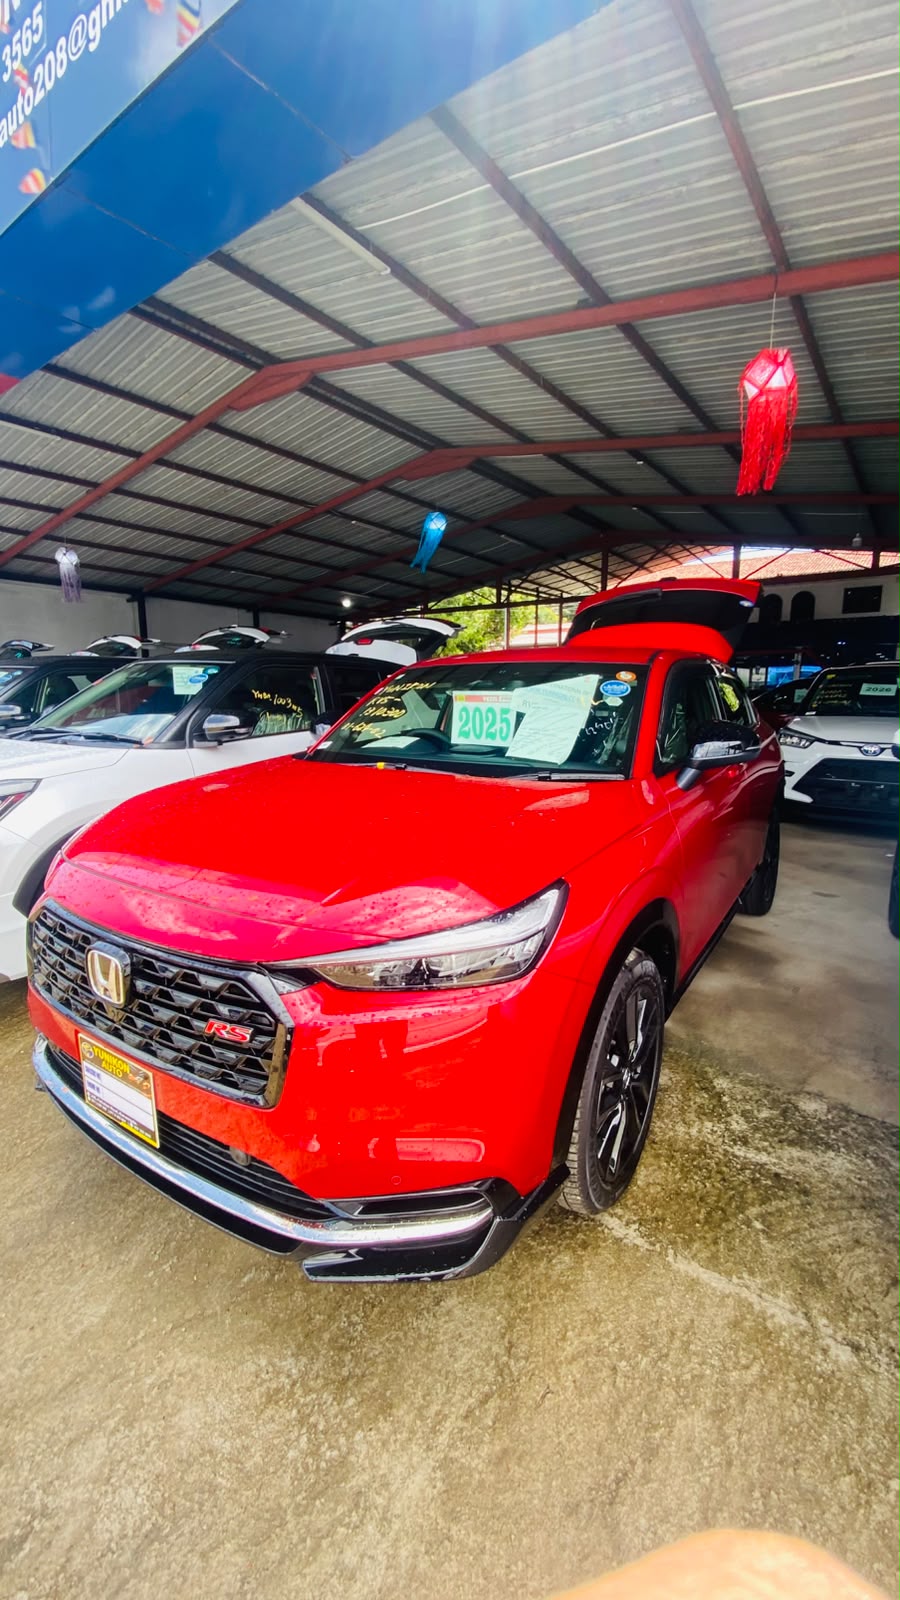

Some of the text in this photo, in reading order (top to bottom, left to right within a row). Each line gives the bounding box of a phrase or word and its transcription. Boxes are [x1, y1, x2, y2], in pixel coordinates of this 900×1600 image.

[2, 1, 43, 82] 3565
[457, 706, 511, 742] 2025
[204, 1019, 254, 1043] RS
[92, 1046, 130, 1073] YUNIKON
[102, 1060, 123, 1078] AUTO
